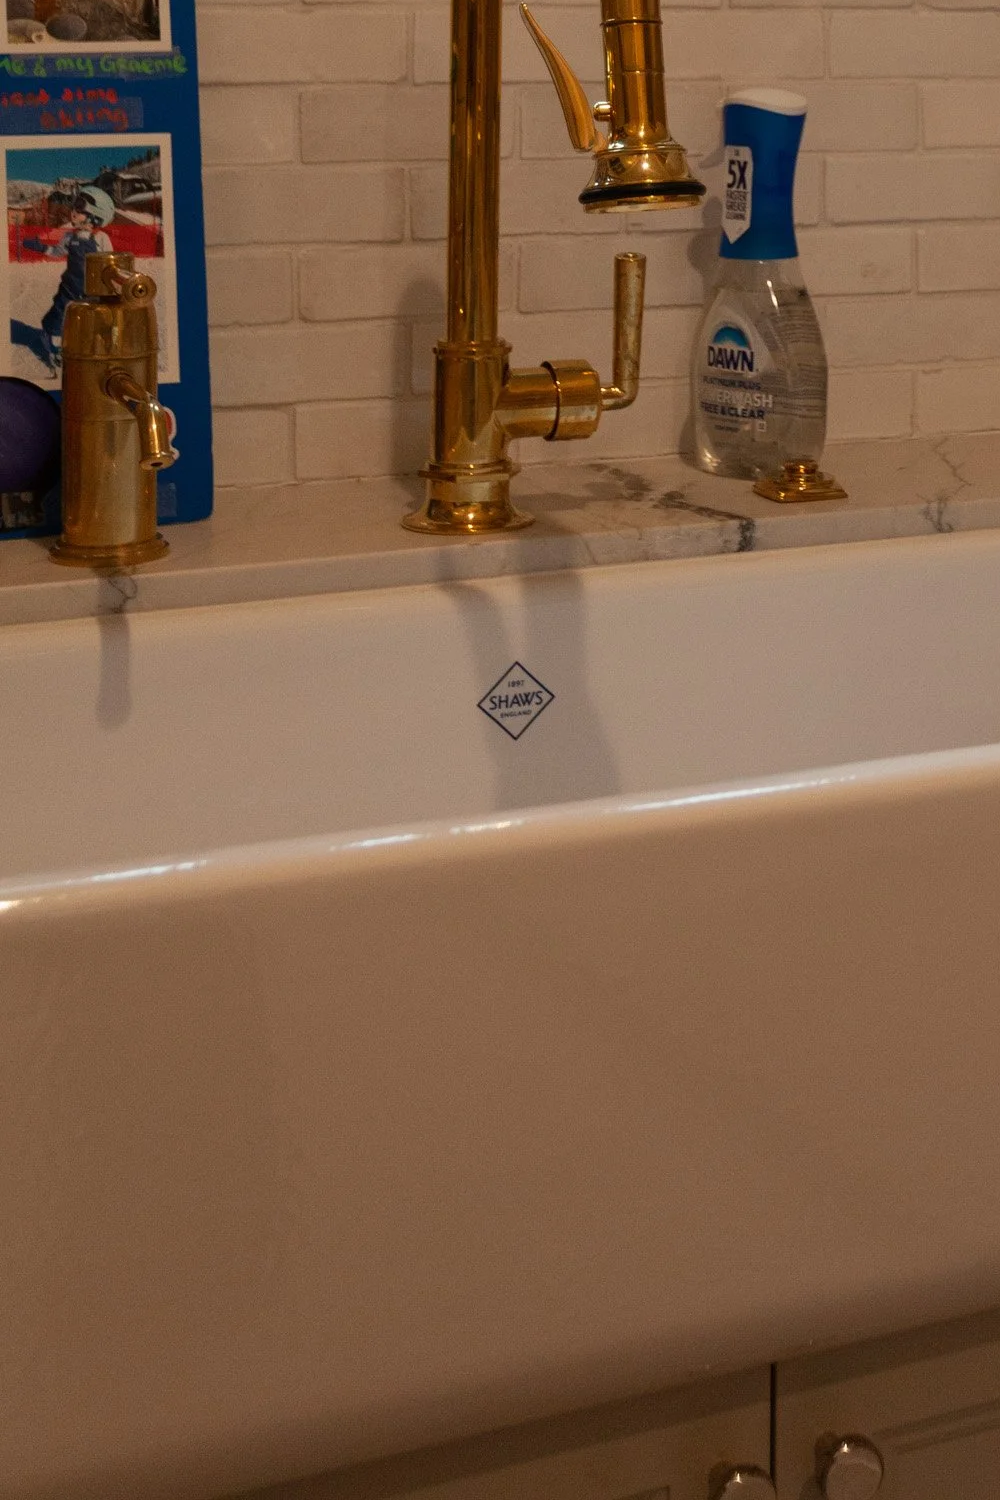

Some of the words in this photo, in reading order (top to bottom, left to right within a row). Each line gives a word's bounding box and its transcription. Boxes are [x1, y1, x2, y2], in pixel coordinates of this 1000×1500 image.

[55, 57, 94, 78] my
[727, 159, 748, 189] 5X
[707, 345, 754, 372] DAWN
[728, 406, 765, 420] CLEAR
[489, 691, 544, 710] SHAWS
[500, 709, 532, 718] ENGLAND
